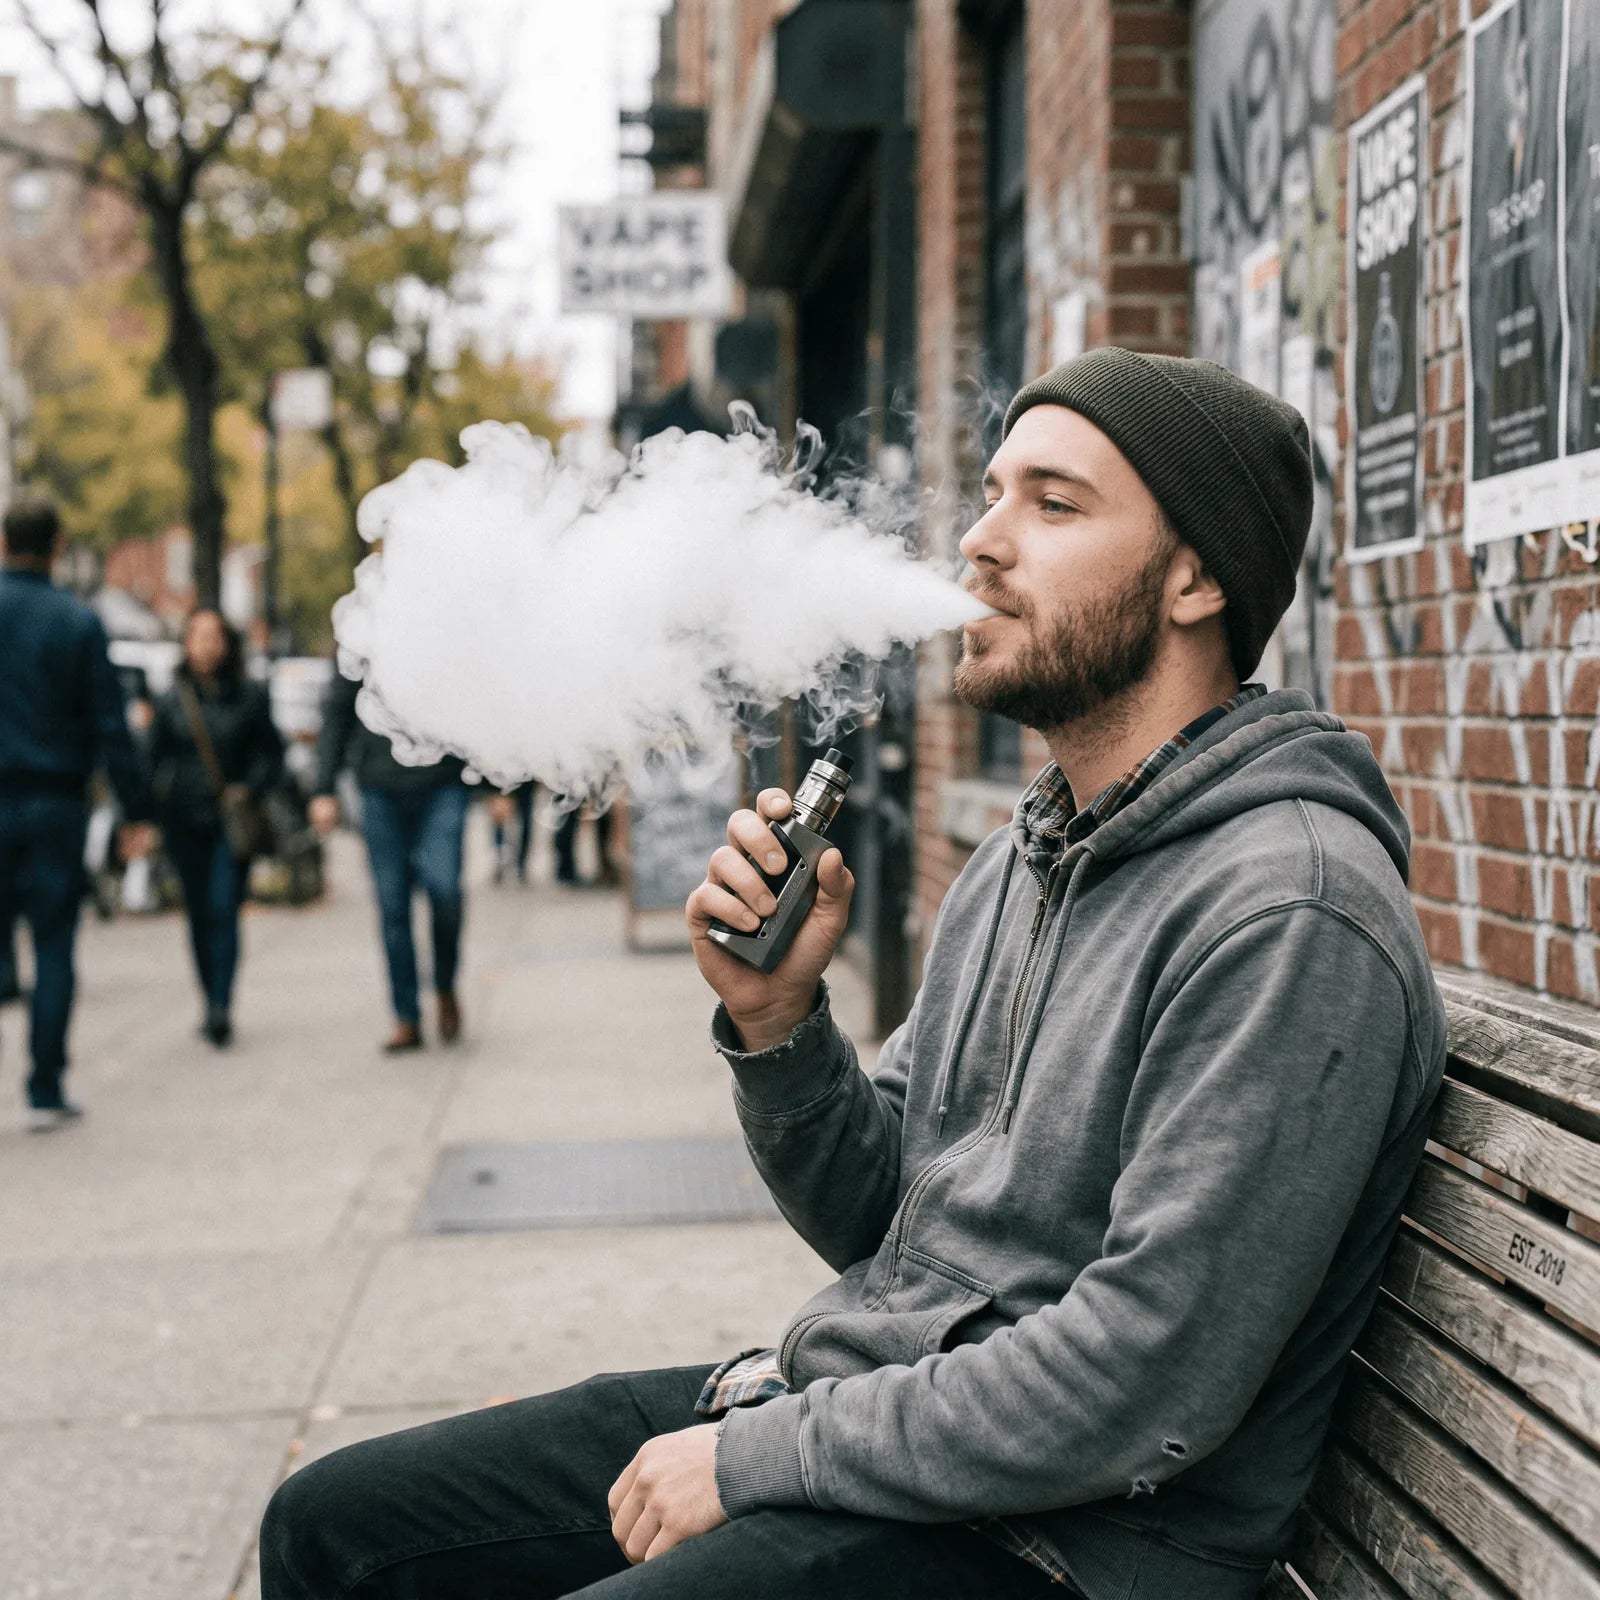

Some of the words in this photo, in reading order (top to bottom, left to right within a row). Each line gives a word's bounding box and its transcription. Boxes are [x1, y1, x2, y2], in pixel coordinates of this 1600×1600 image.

[1357, 178, 1417, 270] SHOP
[1508, 1233, 1536, 1270] EST.
[1534, 1248, 1566, 1287] 2018
